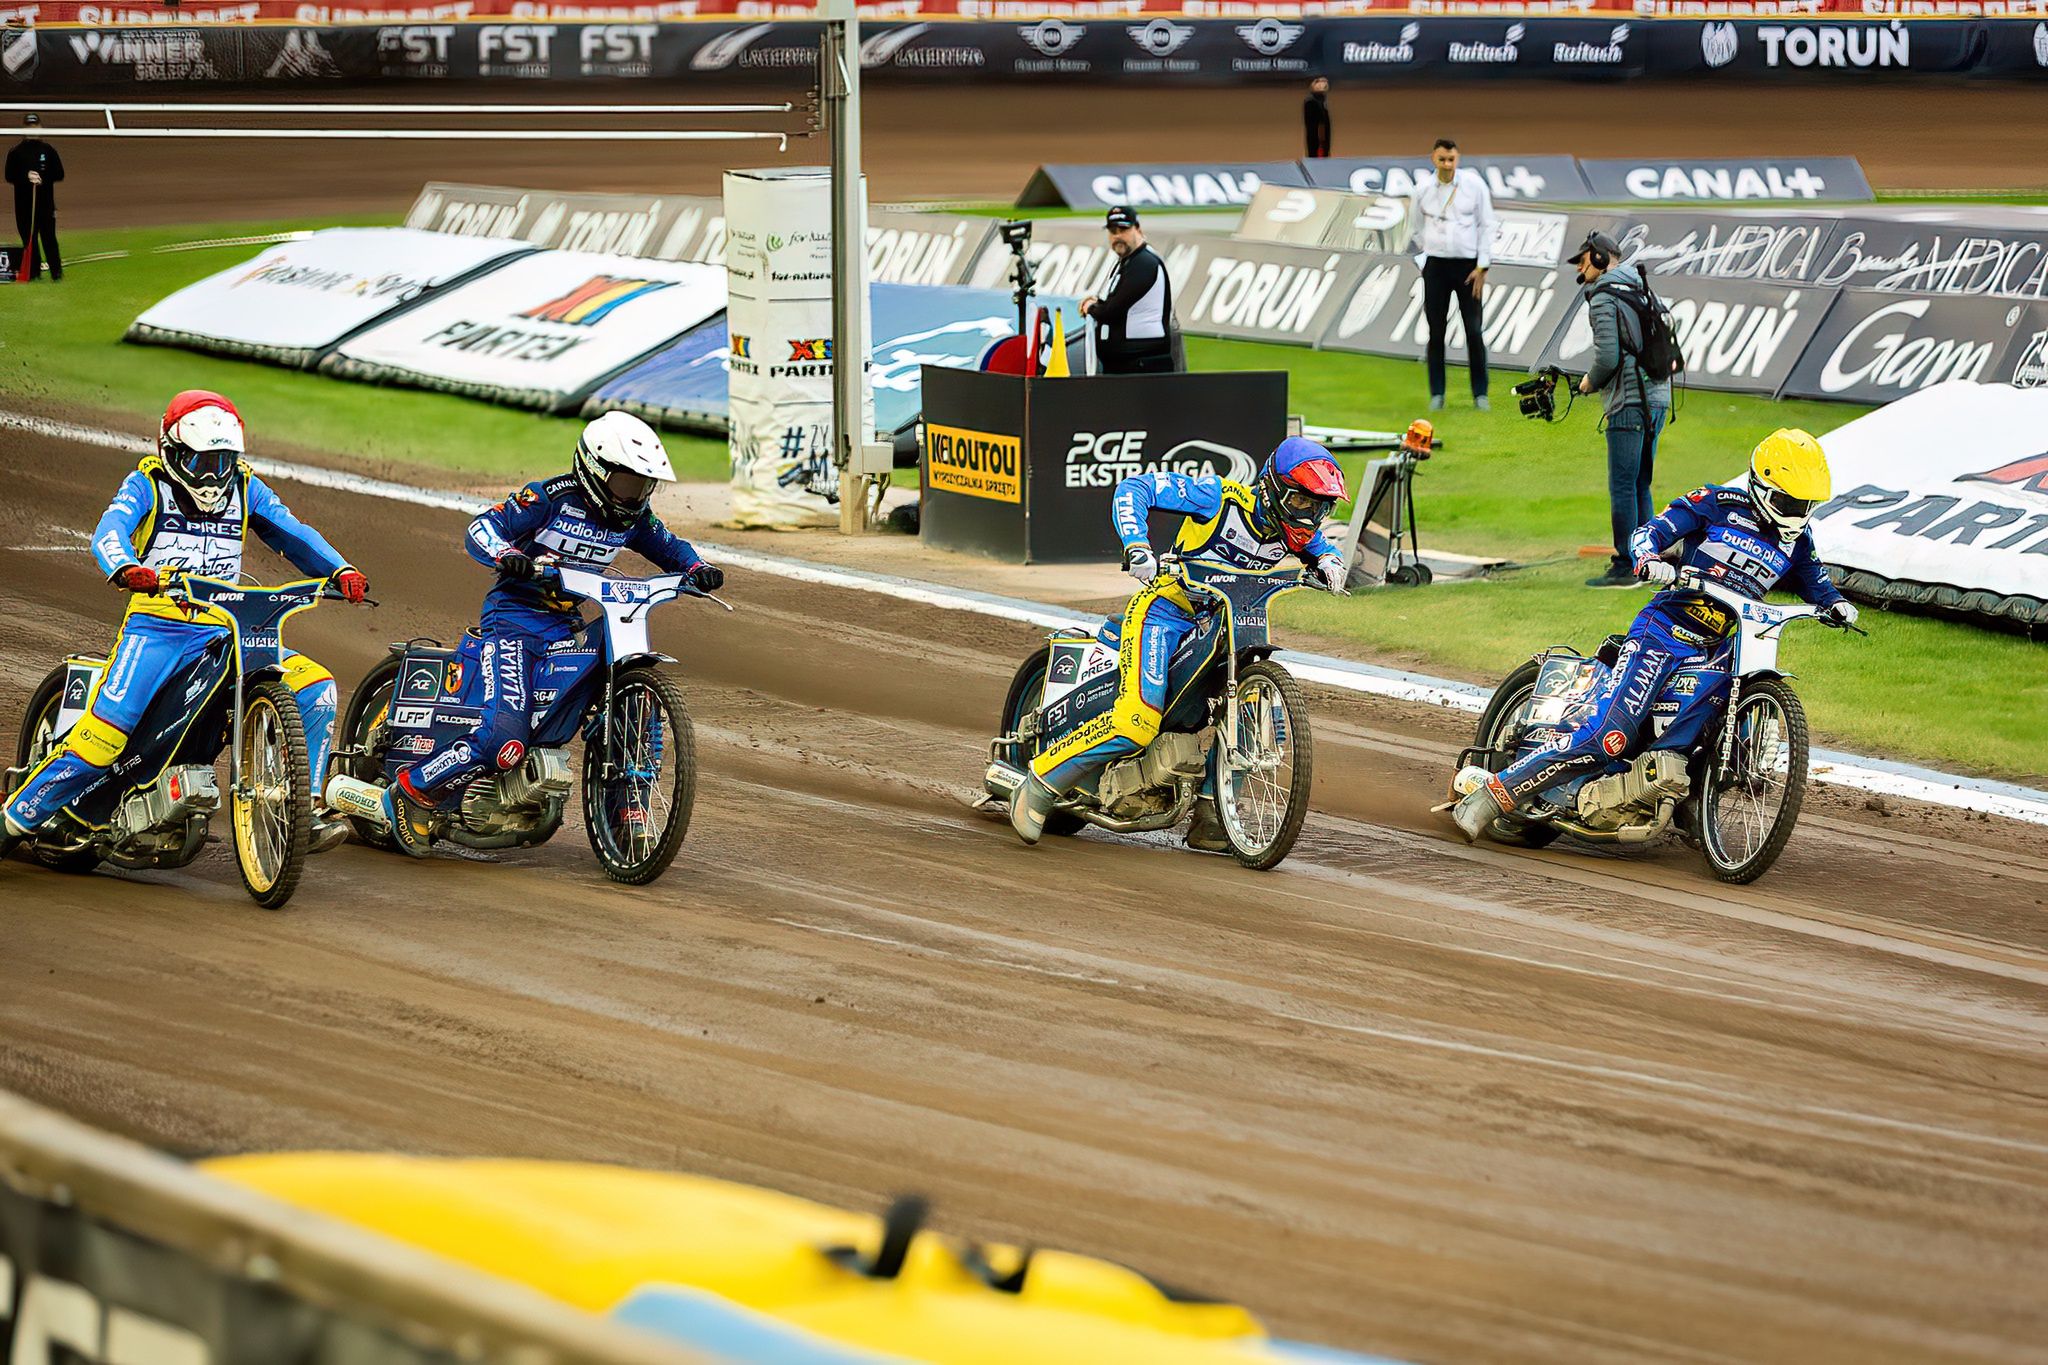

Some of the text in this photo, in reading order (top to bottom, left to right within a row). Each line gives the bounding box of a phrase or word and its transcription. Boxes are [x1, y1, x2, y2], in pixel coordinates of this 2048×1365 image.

[378, 26, 454, 62] FST
[478, 26, 557, 62] FST
[580, 25, 659, 62] FST
[1758, 20, 1910, 67] TORUŃ
[1350, 167, 1545, 198] CAL+
[1626, 167, 1825, 199] CANAL+
[1190, 253, 1340, 333] TORUŃ
[1390, 270, 1559, 354] TUŃ
[1661, 289, 1801, 378] ORUŃ
[1066, 431, 1147, 463] PGE
[546, 480, 578, 496] CANAL+
[1717, 493, 1750, 504] CANAL+
[1813, 484, 2048, 556] PART
[1722, 530, 1775, 564] budio.pl
[1205, 575, 1237, 583] LAVOR
[1727, 551, 1772, 580] LFP
[208, 592, 245, 602] LAVOR
[411, 679, 432, 690] PGE
[499, 638, 519, 711] ALMAR
[1081, 659, 1113, 681] PRES
[1624, 649, 1664, 716] ALMAR
[398, 711, 425, 724] LFP
[435, 714, 483, 727] POLCOPPER
[1048, 698, 1069, 726] FST
[1720, 678, 1741, 761] POLCOPPER
